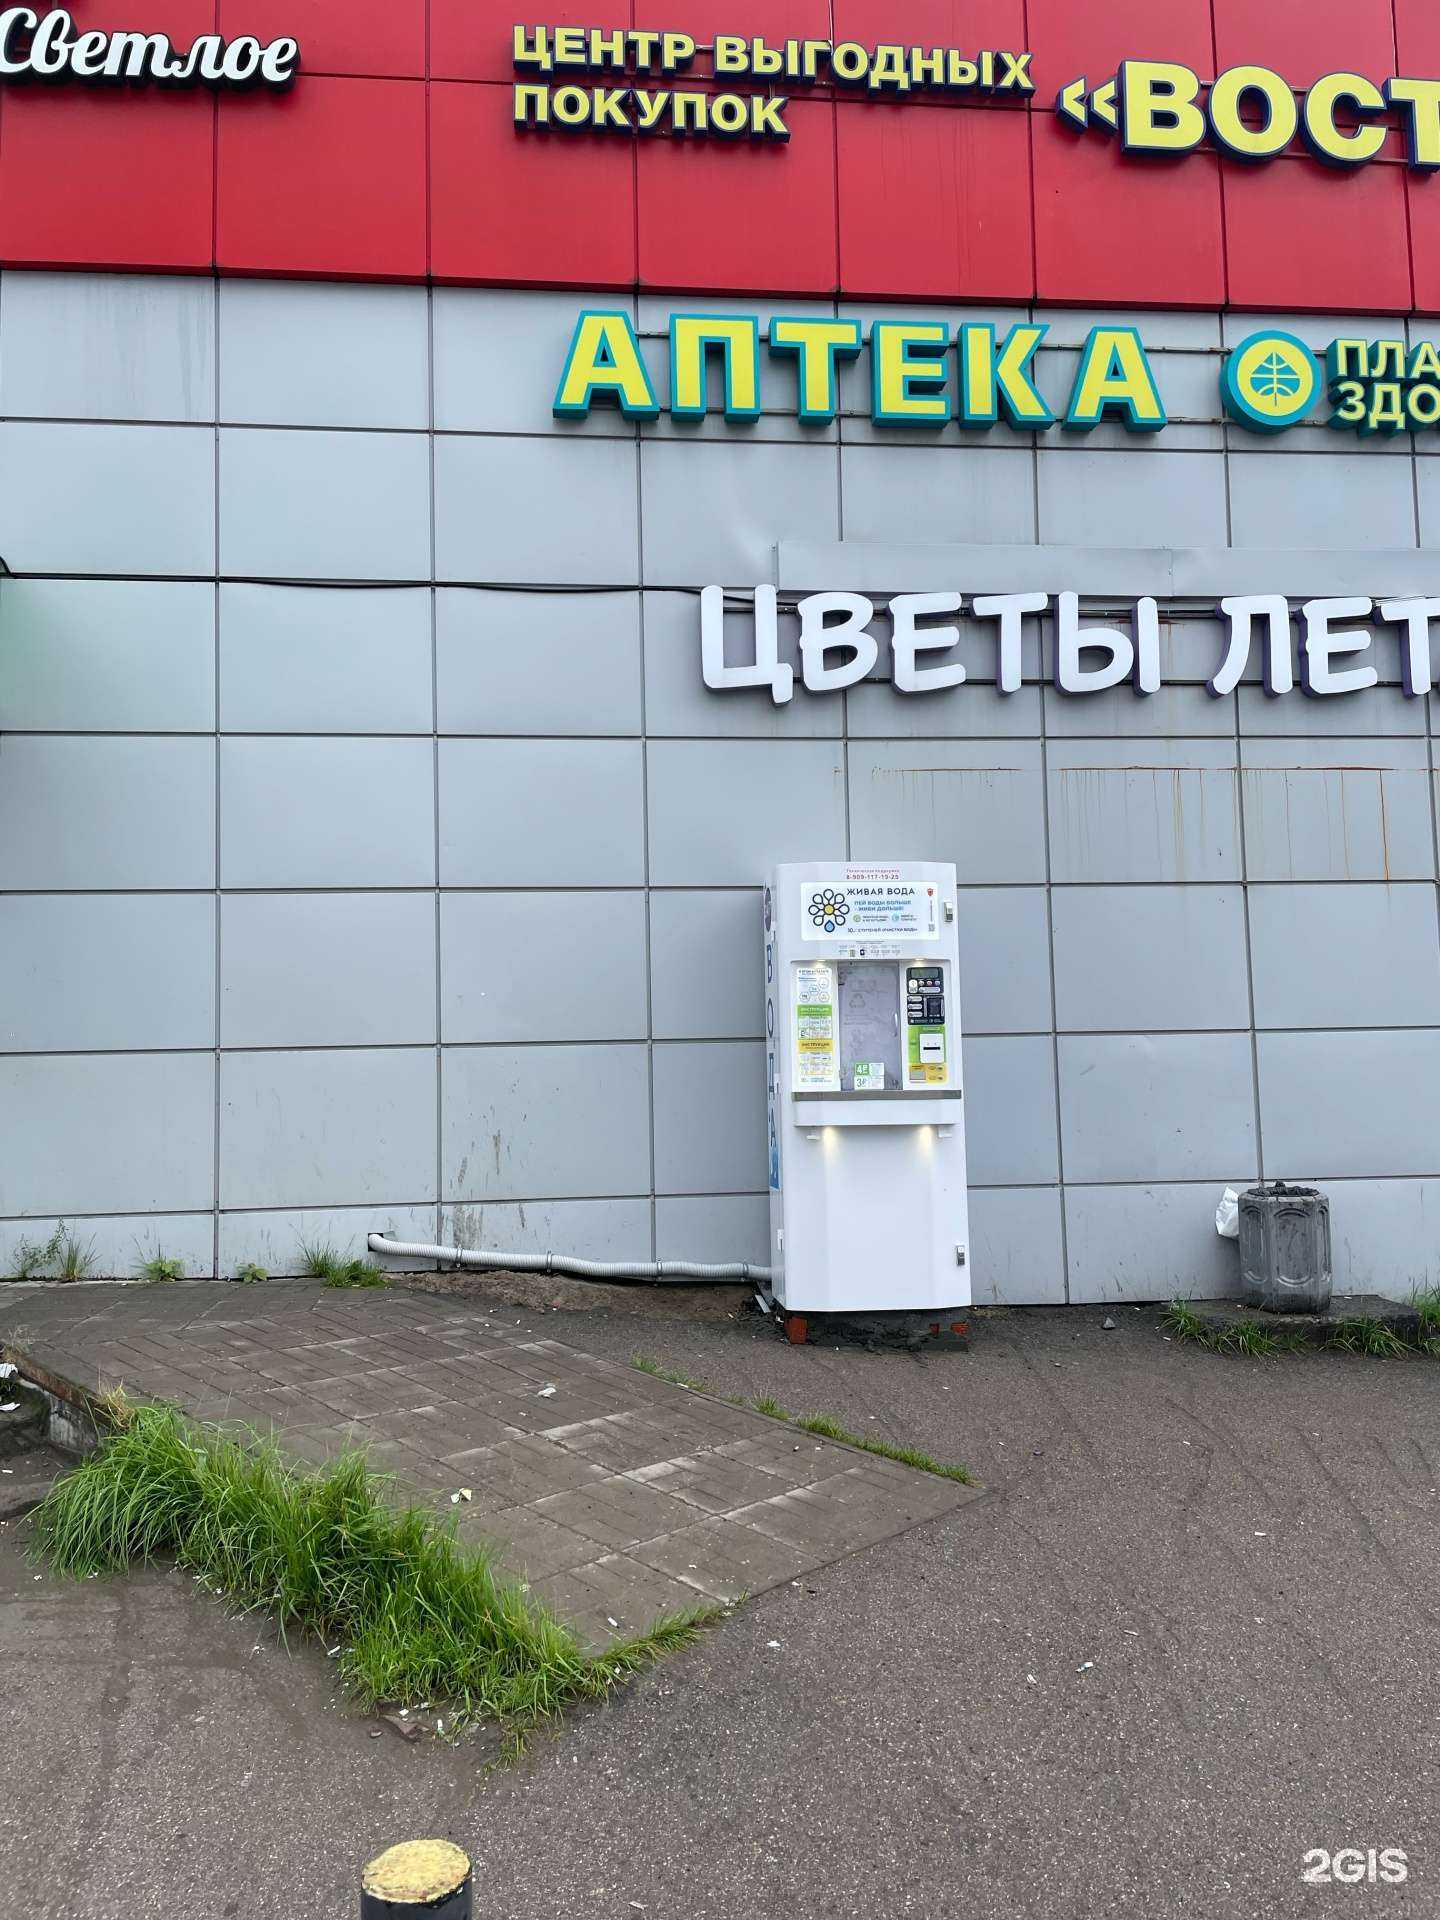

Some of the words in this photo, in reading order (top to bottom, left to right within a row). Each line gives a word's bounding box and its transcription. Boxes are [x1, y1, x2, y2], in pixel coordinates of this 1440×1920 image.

[0, 7, 298, 83] Светлое
[513, 25, 696, 72] ЦЕНТР
[714, 34, 1033, 91] ВЫГОДНЫХ
[514, 84, 790, 133] ПОКУПОК
[555, 310, 1167, 432] АПТЕКА
[700, 584, 1161, 706] ЦВЕТЫ
[1211, 594, 1440, 698] ЛЕТ
[846, 887, 883, 896] ЖИВАЯ
[887, 887, 915, 896] ВОДА
